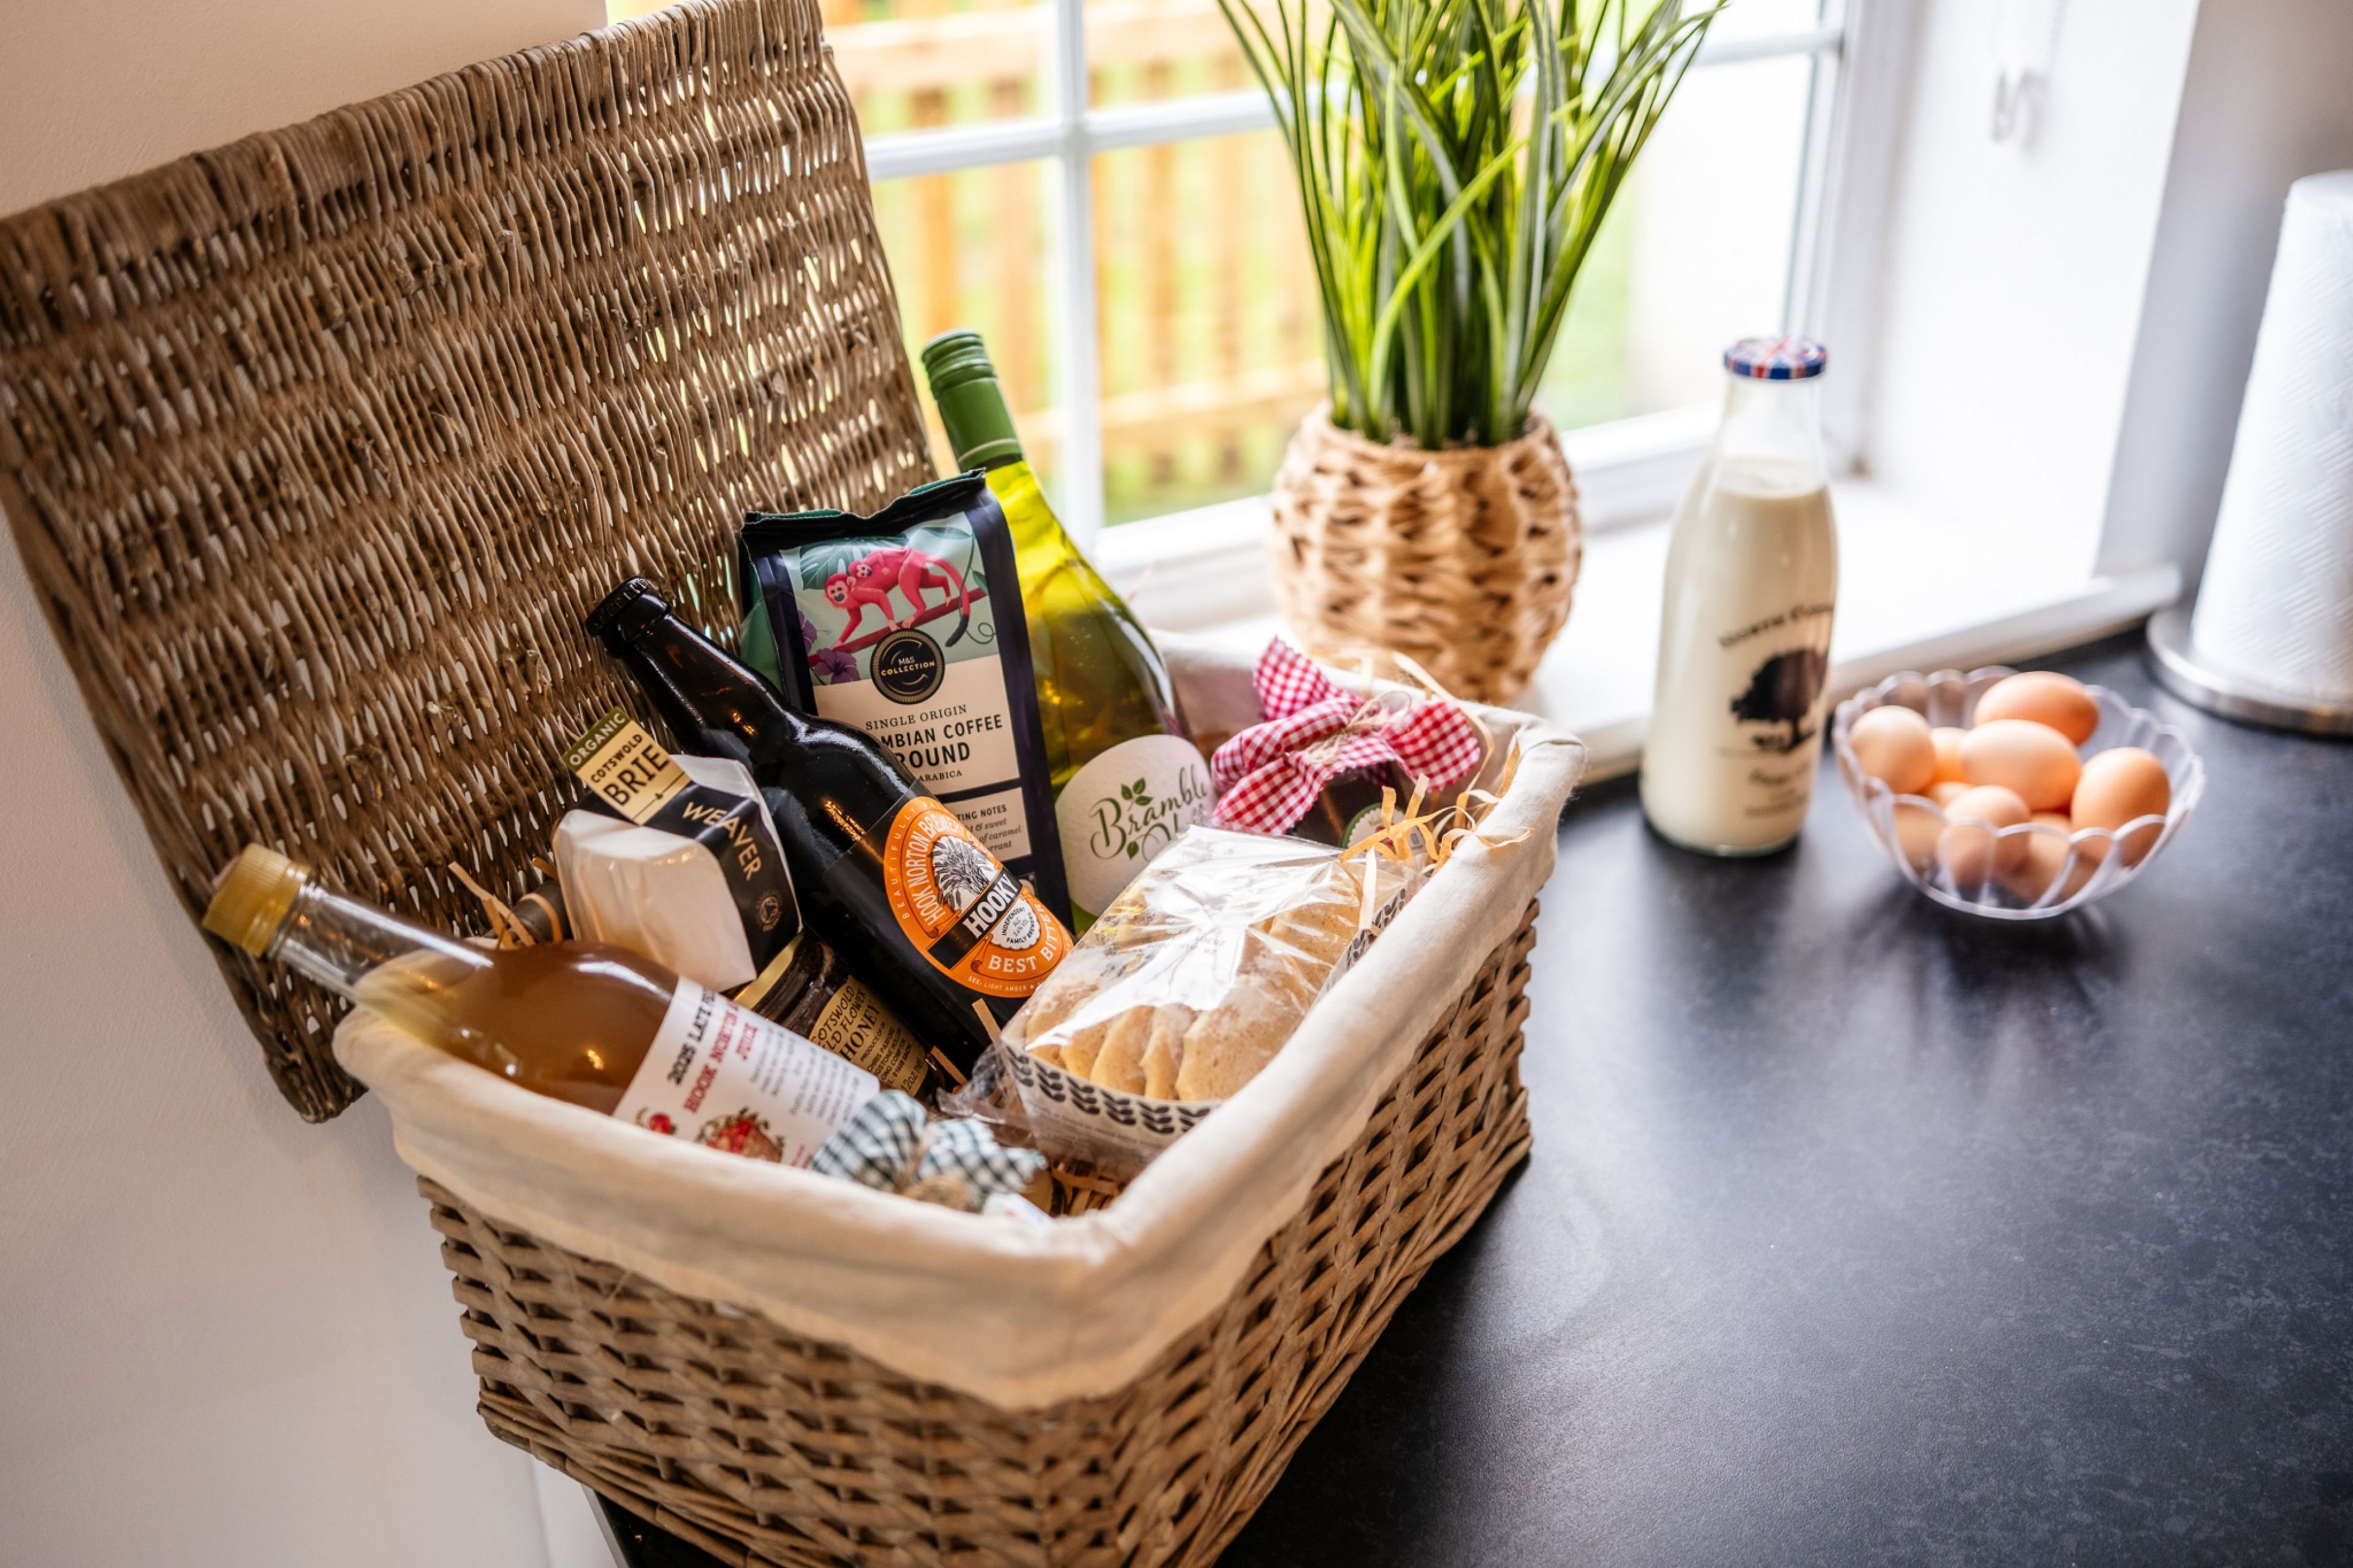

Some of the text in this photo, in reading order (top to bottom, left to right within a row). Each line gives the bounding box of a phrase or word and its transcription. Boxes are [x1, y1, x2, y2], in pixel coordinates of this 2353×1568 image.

[881, 661, 935, 676] COLLECTION
[898, 656, 915, 665] M&S
[865, 704, 968, 730] SINGLE ORIGIN
[881, 714, 1002, 749] MBIAN COFFEE
[569, 713, 626, 765] ORGANIC
[895, 741, 971, 768] ROUND
[590, 733, 643, 783] COTSWOLD
[603, 743, 670, 806] BRIE
[919, 770, 963, 782] ARABICA
[957, 804, 1007, 821] TING NOTES
[984, 818, 1006, 828] sweet
[681, 801, 762, 881] WEAVER
[979, 833, 988, 844] of
[989, 825, 1022, 841] caramel
[988, 842, 1012, 852] rrant
[890, 808, 916, 920] BEAUTIFULLY
[905, 830, 931, 888] NORTON
[912, 885, 946, 926] HOOK
[962, 873, 1019, 939] HOOKY
[988, 954, 1037, 973] BEST
[1034, 903, 1058, 961] BITTER
[984, 981, 1003, 990] LIGHT
[840, 988, 866, 1033] FLOWER
[839, 1004, 881, 1062] HONEY
[860, 1034, 879, 1062] PRODUCE
[867, 1053, 882, 1072] CHRIS
[881, 1066, 893, 1080] ONG
[683, 1063, 718, 1113] HOOK
